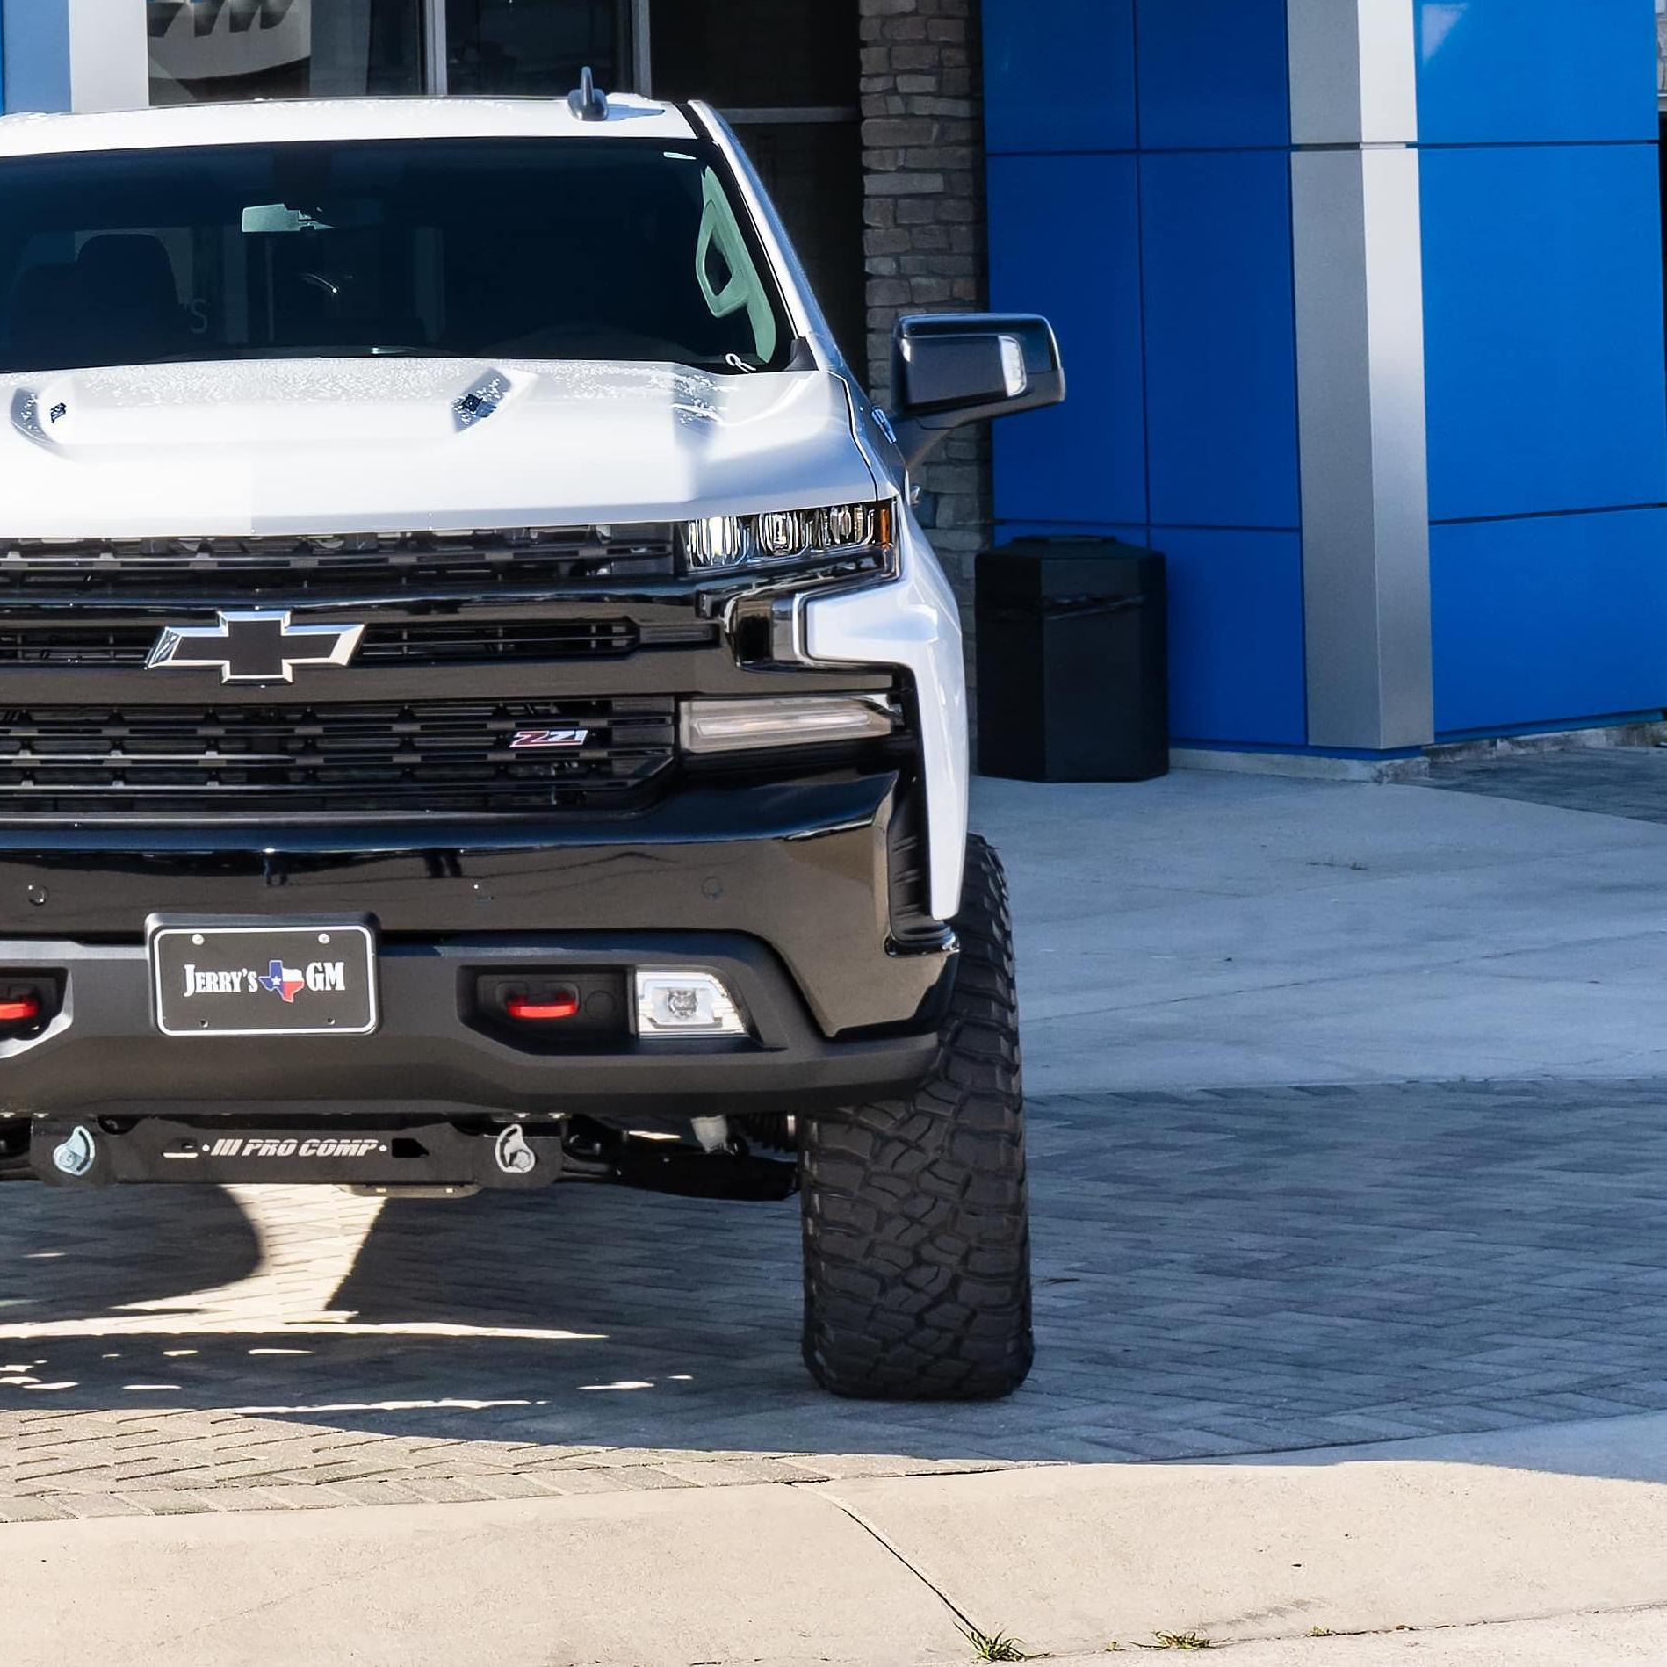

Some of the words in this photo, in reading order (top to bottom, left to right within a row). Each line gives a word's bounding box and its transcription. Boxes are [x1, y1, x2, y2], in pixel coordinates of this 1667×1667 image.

[306, 961, 346, 992] GM
[241, 1138, 299, 1157] PRO
[299, 1138, 379, 1157] COMP
